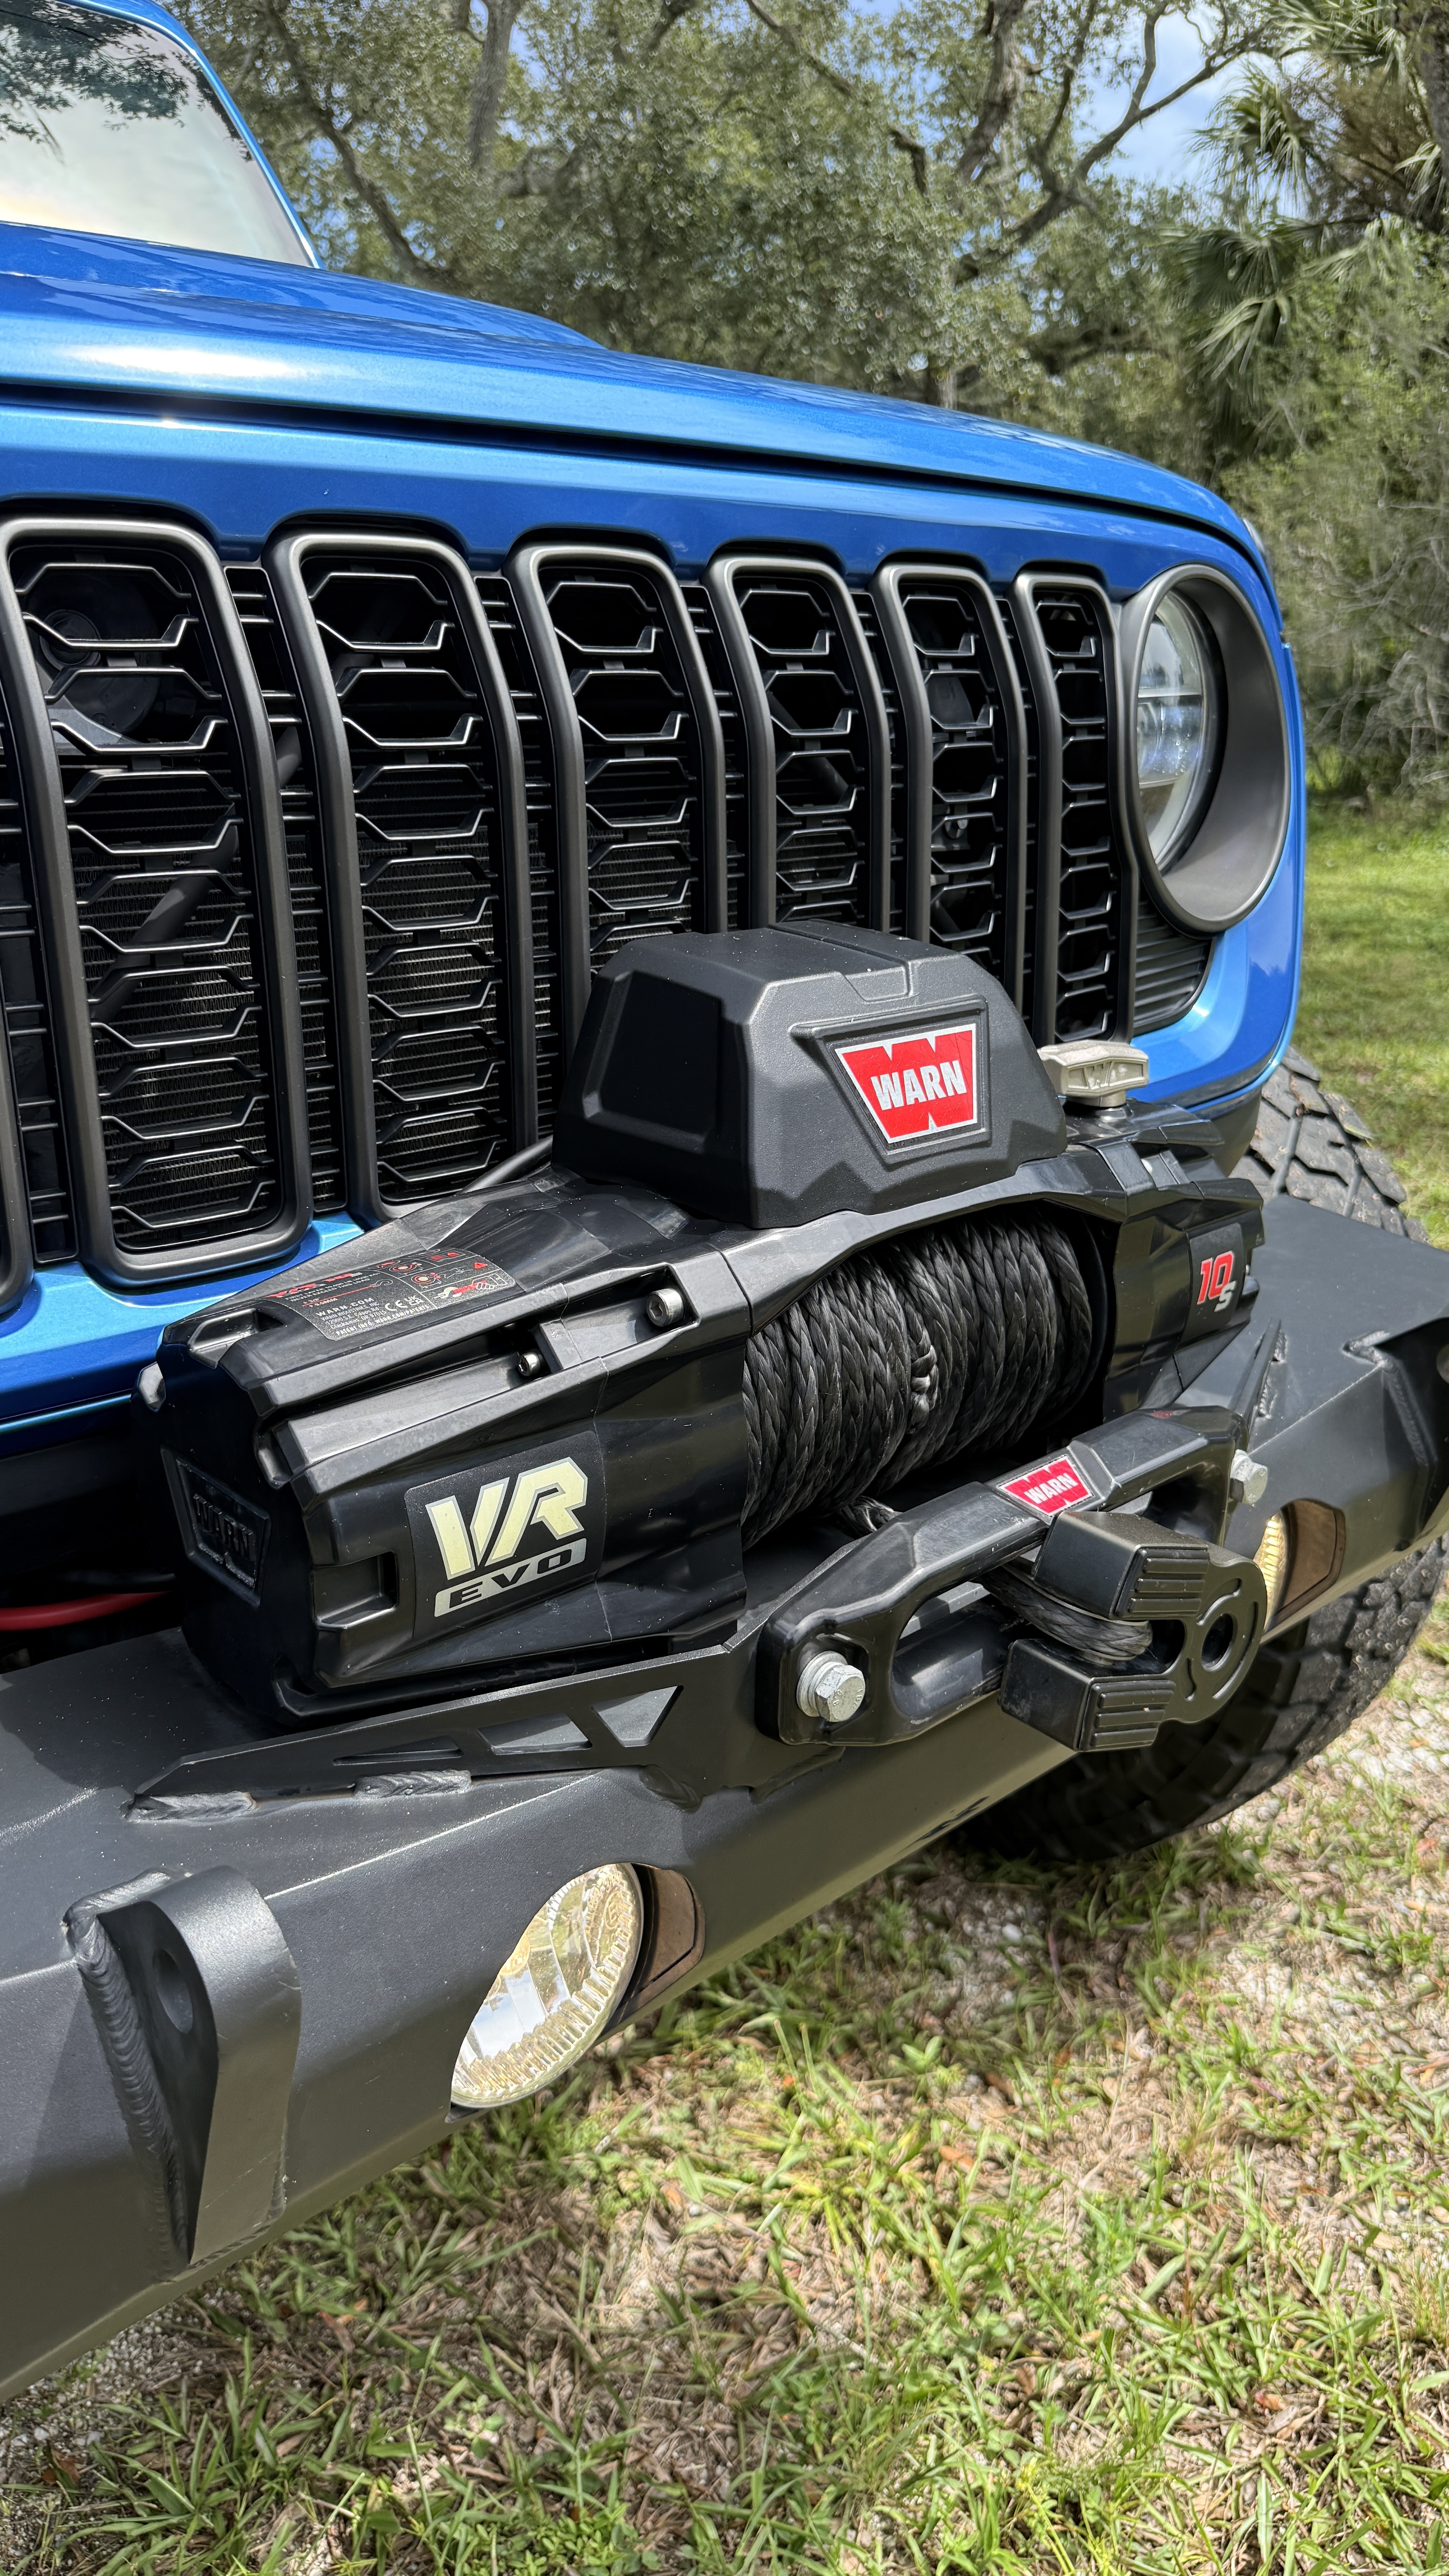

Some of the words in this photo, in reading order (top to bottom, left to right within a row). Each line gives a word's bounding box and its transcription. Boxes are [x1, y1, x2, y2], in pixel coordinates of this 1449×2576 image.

[870, 1060, 967, 1111] WARN
[316, 1297, 375, 1316] WARN.COM
[321, 1313, 338, 1321] WARN
[335, 1325, 358, 1336] PATENT
[1024, 1472, 1078, 1504] WARN
[425, 1457, 588, 1580] VR
[449, 1549, 572, 1609] EVO
